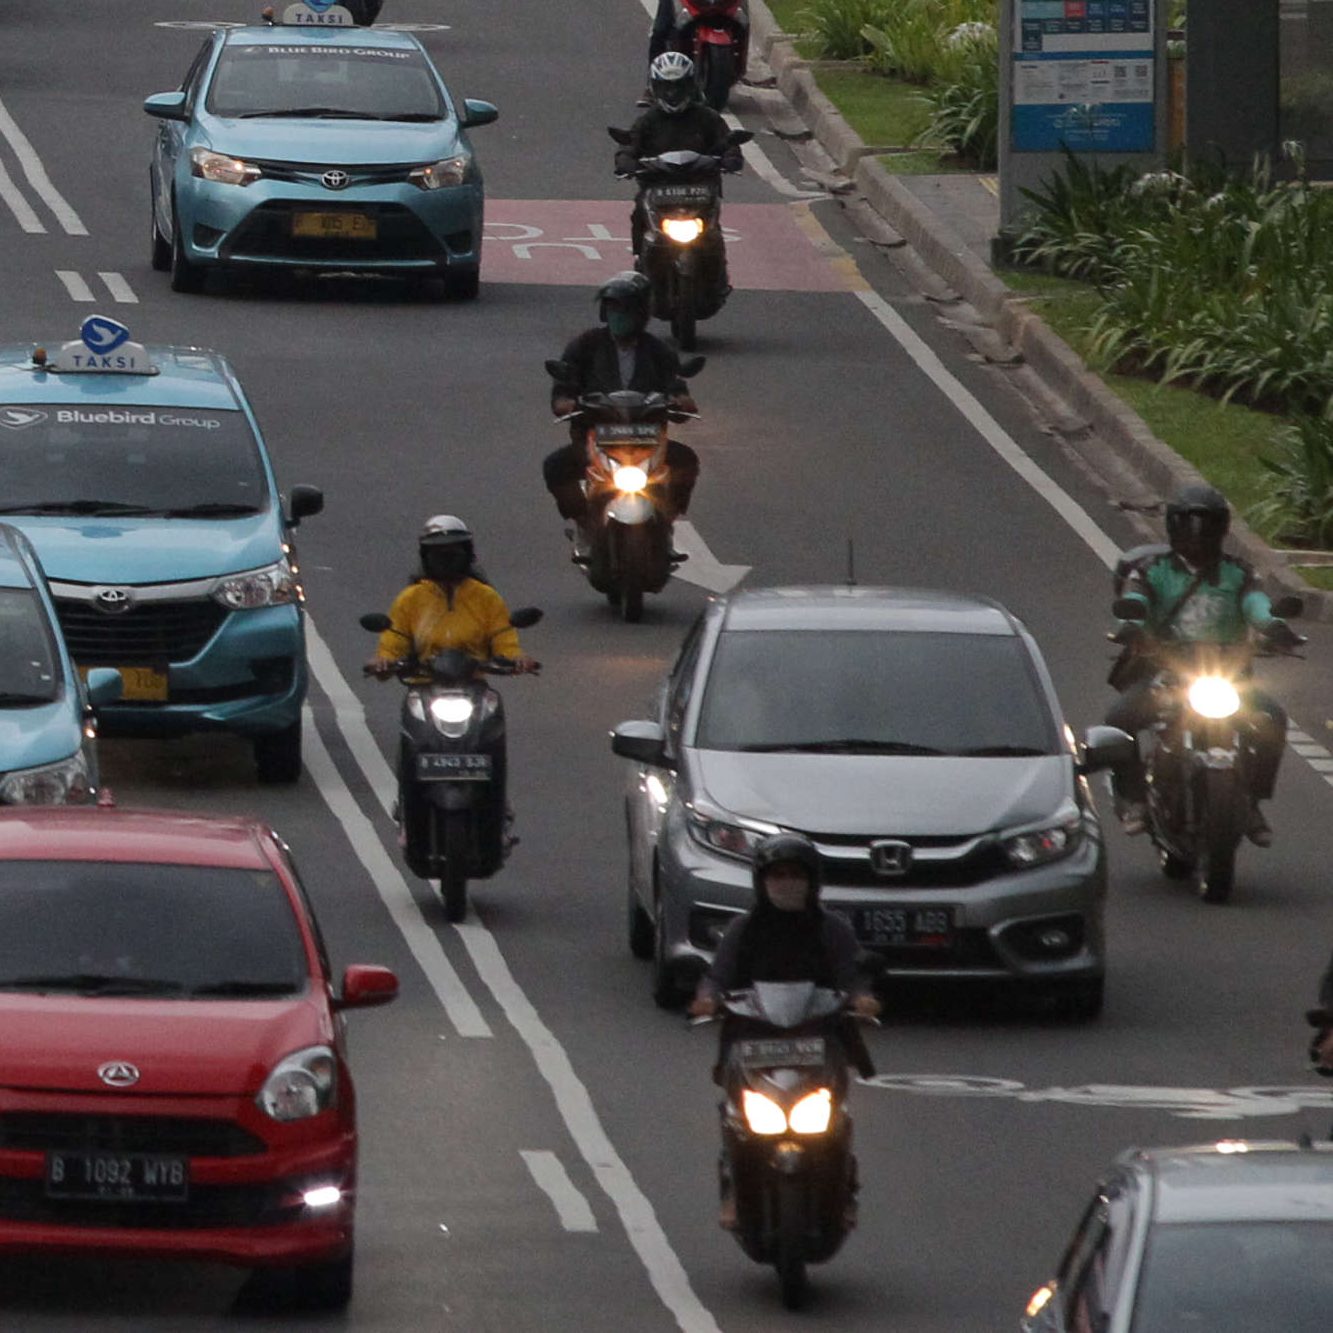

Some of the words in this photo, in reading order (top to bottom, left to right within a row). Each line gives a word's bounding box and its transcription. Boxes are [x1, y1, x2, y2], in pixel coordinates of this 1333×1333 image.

[295, 13, 344, 24] TAKSI
[268, 45, 307, 55] BLUE
[311, 47, 348, 56] BIRD
[353, 48, 410, 59] GROUP
[72, 355, 136, 369] TAKSI
[56, 409, 156, 426] Bluebird
[160, 412, 221, 430] Group
[51, 1156, 65, 1184] B
[84, 1157, 133, 1185] 1092
